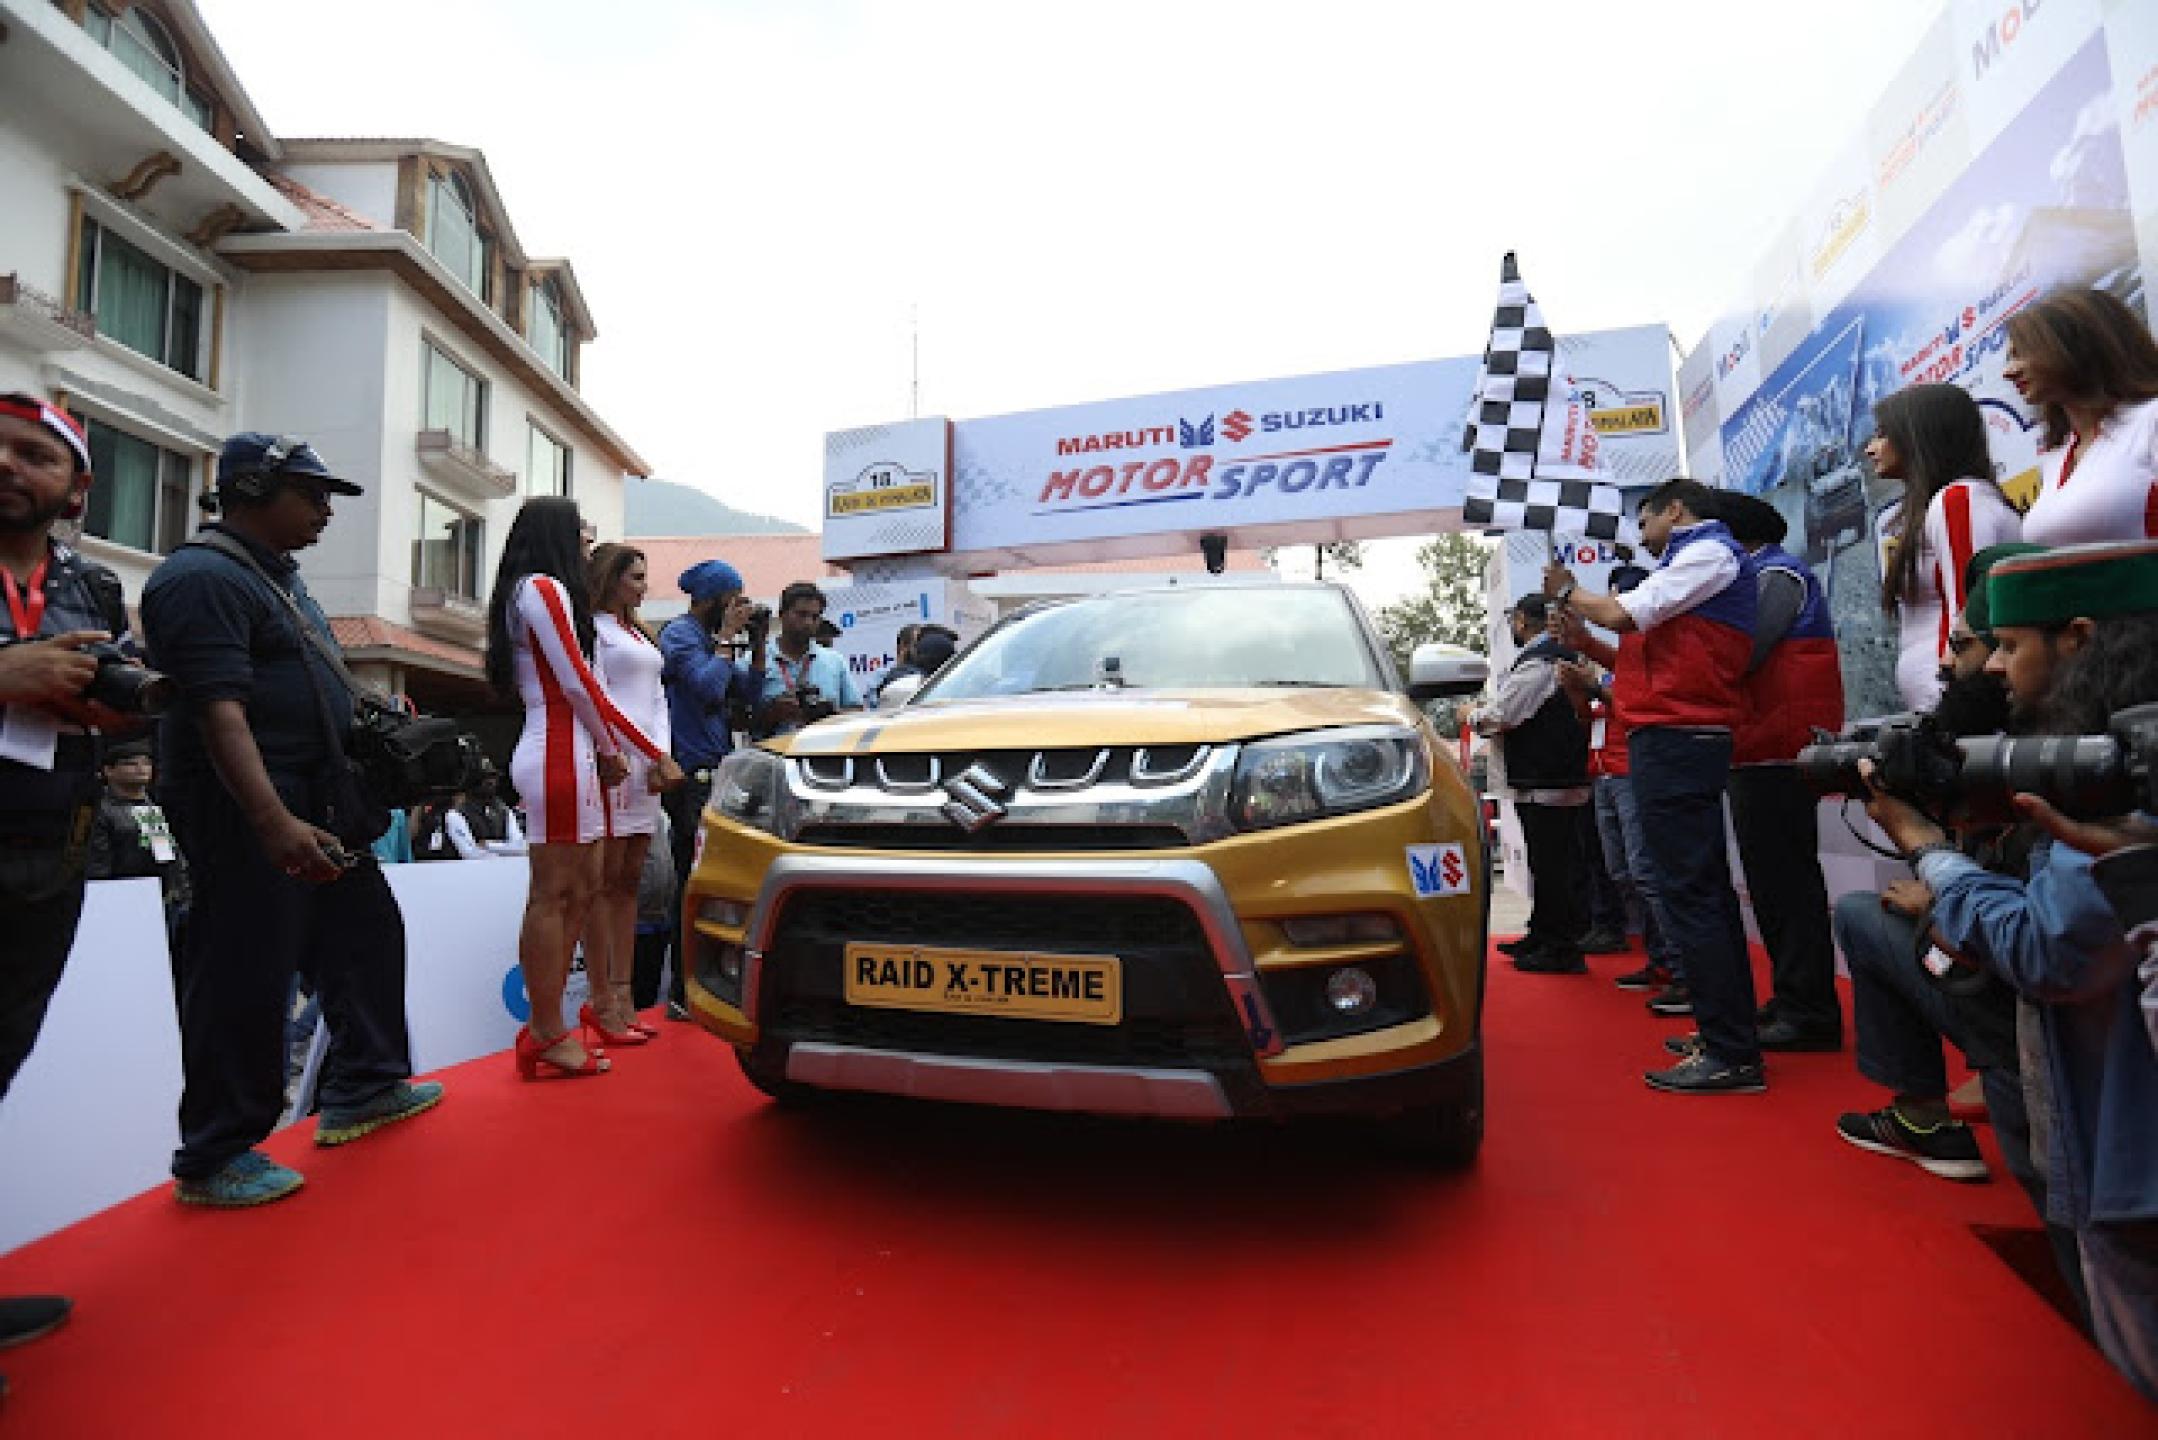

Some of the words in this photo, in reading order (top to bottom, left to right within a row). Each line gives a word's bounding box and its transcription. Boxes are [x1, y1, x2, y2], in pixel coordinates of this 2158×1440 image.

[1058, 425, 1174, 456] MARUTI
[1261, 401, 1384, 432] SUZUKI
[856, 957, 935, 989] RAID
[947, 964, 1104, 999] X-TREME
